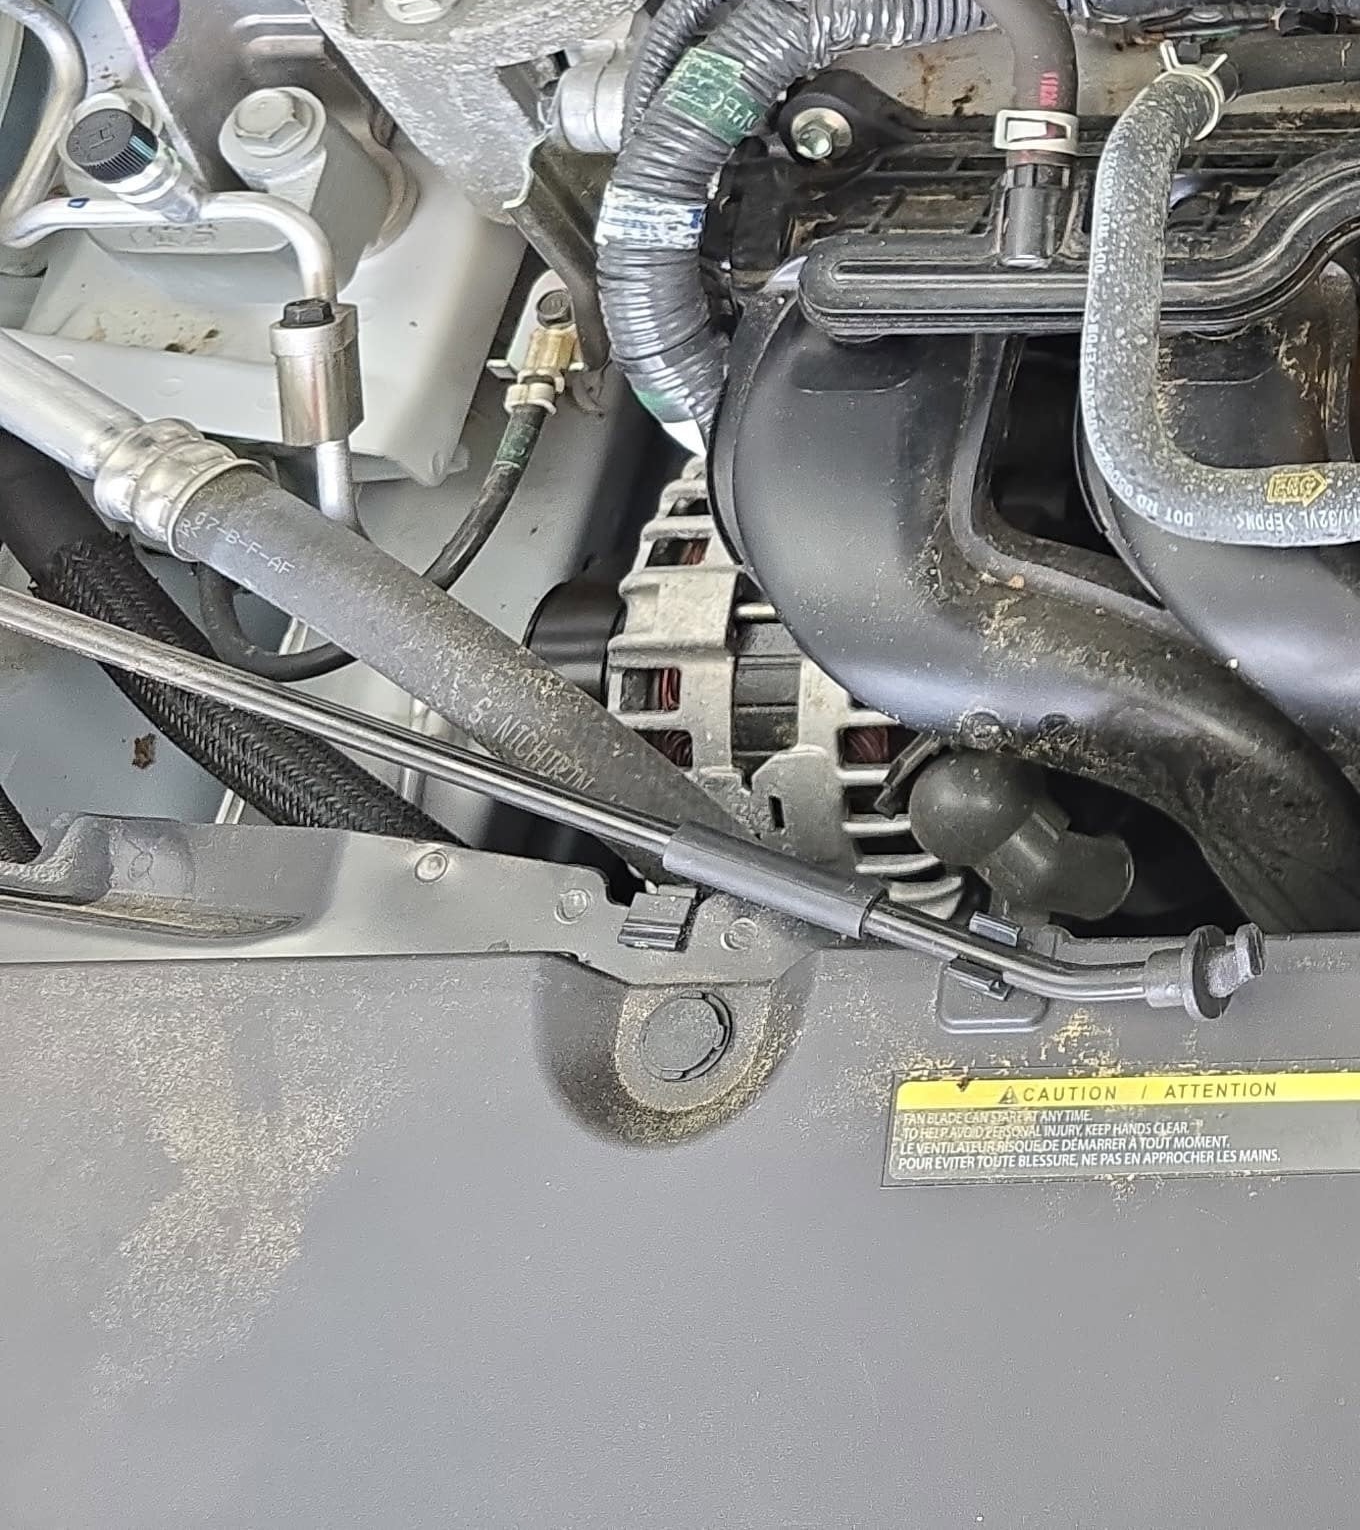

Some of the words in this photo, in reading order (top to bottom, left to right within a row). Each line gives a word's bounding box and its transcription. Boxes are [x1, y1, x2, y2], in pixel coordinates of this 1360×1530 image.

[1165, 508, 1194, 527] DOT
[1023, 1086, 1117, 1102] CAUTION
[1164, 1082, 1277, 1098] ATTENTION
[904, 1112, 927, 1125] FAN
[928, 1112, 963, 1124] BLADE
[964, 1112, 991, 1124] CAN
[1041, 1111, 1069, 1122] ANY
[1069, 1110, 1093, 1121] TIME.
[904, 1128, 918, 1140] TO
[951, 1126, 983, 1139] AVOID
[1044, 1125, 1083, 1137] INJURY,
[1085, 1124, 1111, 1136] KEEP
[1113, 1122, 1152, 1135] HANDS
[1152, 1122, 1190, 1134] CLEAR.
[900, 1143, 916, 1155] LE
[917, 1141, 994, 1154] VENTILATEUR
[999, 1140, 1041, 1153] RISQUE
[1043, 1140, 1059, 1151] DE
[1062, 1138, 1126, 1152] DÉMARRER
[1140, 1136, 1172, 1149] TOUT
[1174, 1136, 1230, 1149] MOMENT.
[898, 1157, 932, 1170] POUR
[977, 1155, 1016, 1168] TOUTE
[1019, 1154, 1079, 1168] BLESSURE,
[1082, 1154, 1098, 1166] NE
[1100, 1153, 1122, 1165] PAS
[1124, 1152, 1142, 1165] EN
[1143, 1151, 1215, 1164] APPROCHER
[1216, 1151, 1238, 1163] LES
[1239, 1150, 1281, 1163] MAINS.
